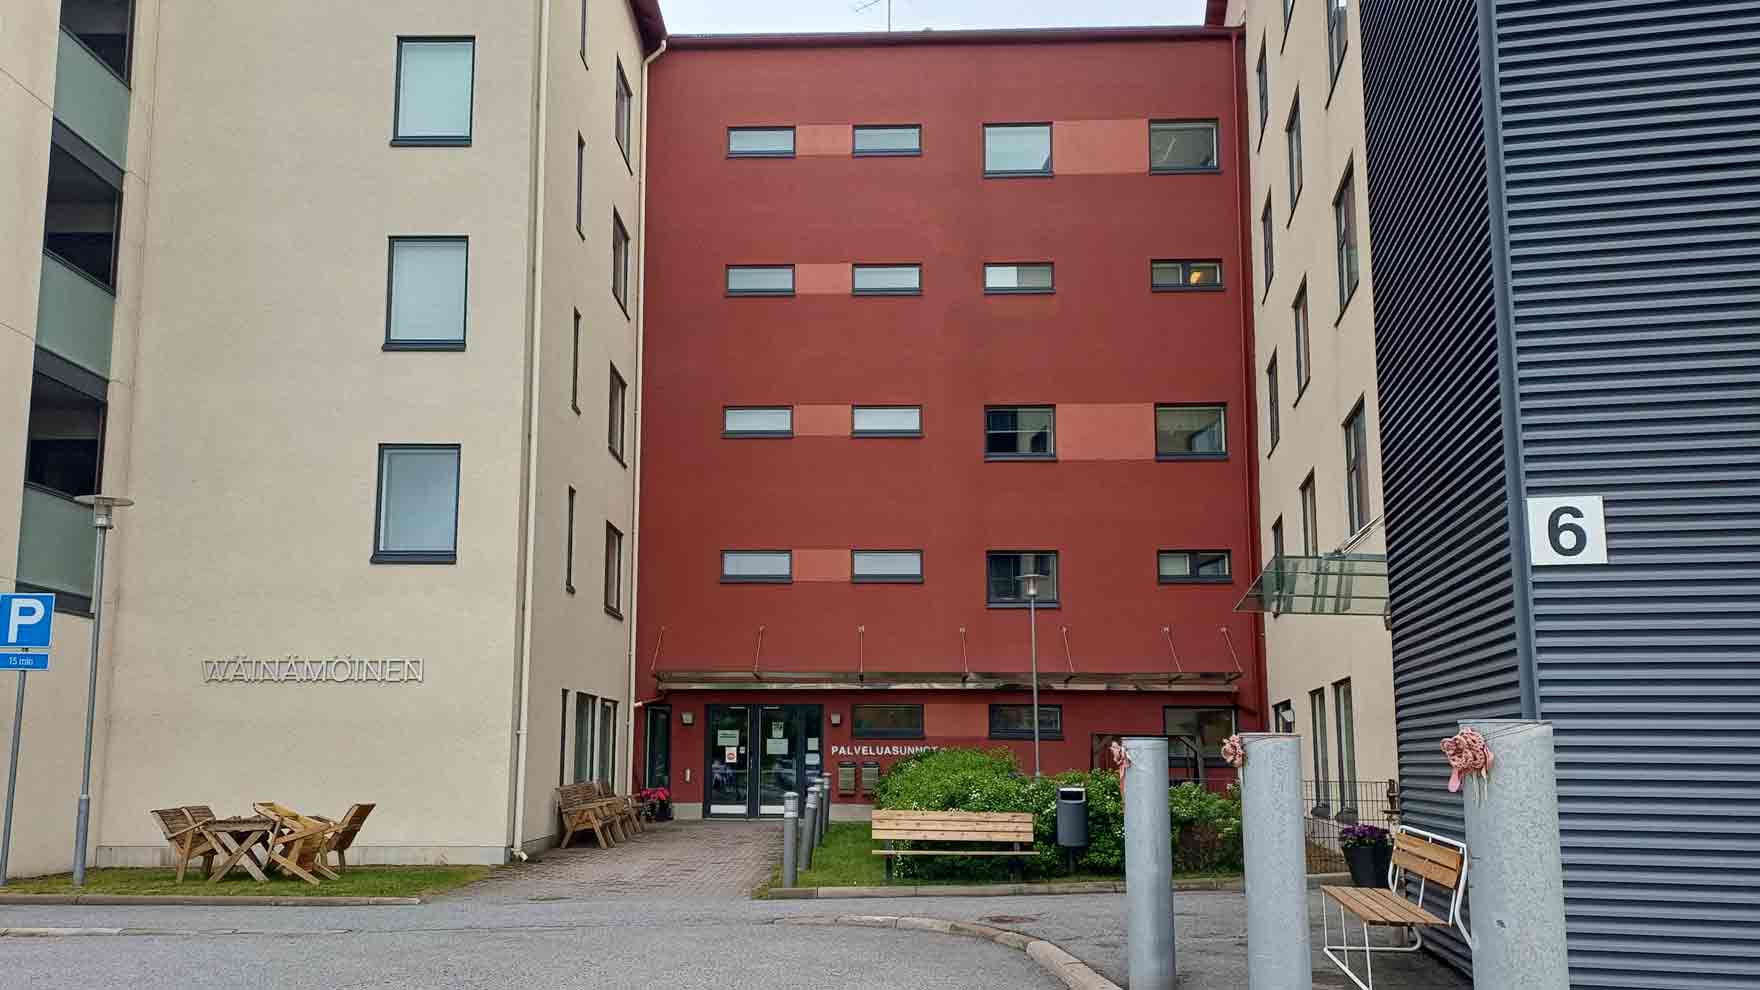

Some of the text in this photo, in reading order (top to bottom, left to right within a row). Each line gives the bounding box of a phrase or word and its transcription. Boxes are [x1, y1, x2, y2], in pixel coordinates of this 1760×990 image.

[1547, 505, 1587, 557] 6
[8, 598, 45, 643] P
[9, 656, 34, 665] 15 min
[201, 654, 424, 683] WÄINÄMÖINEN
